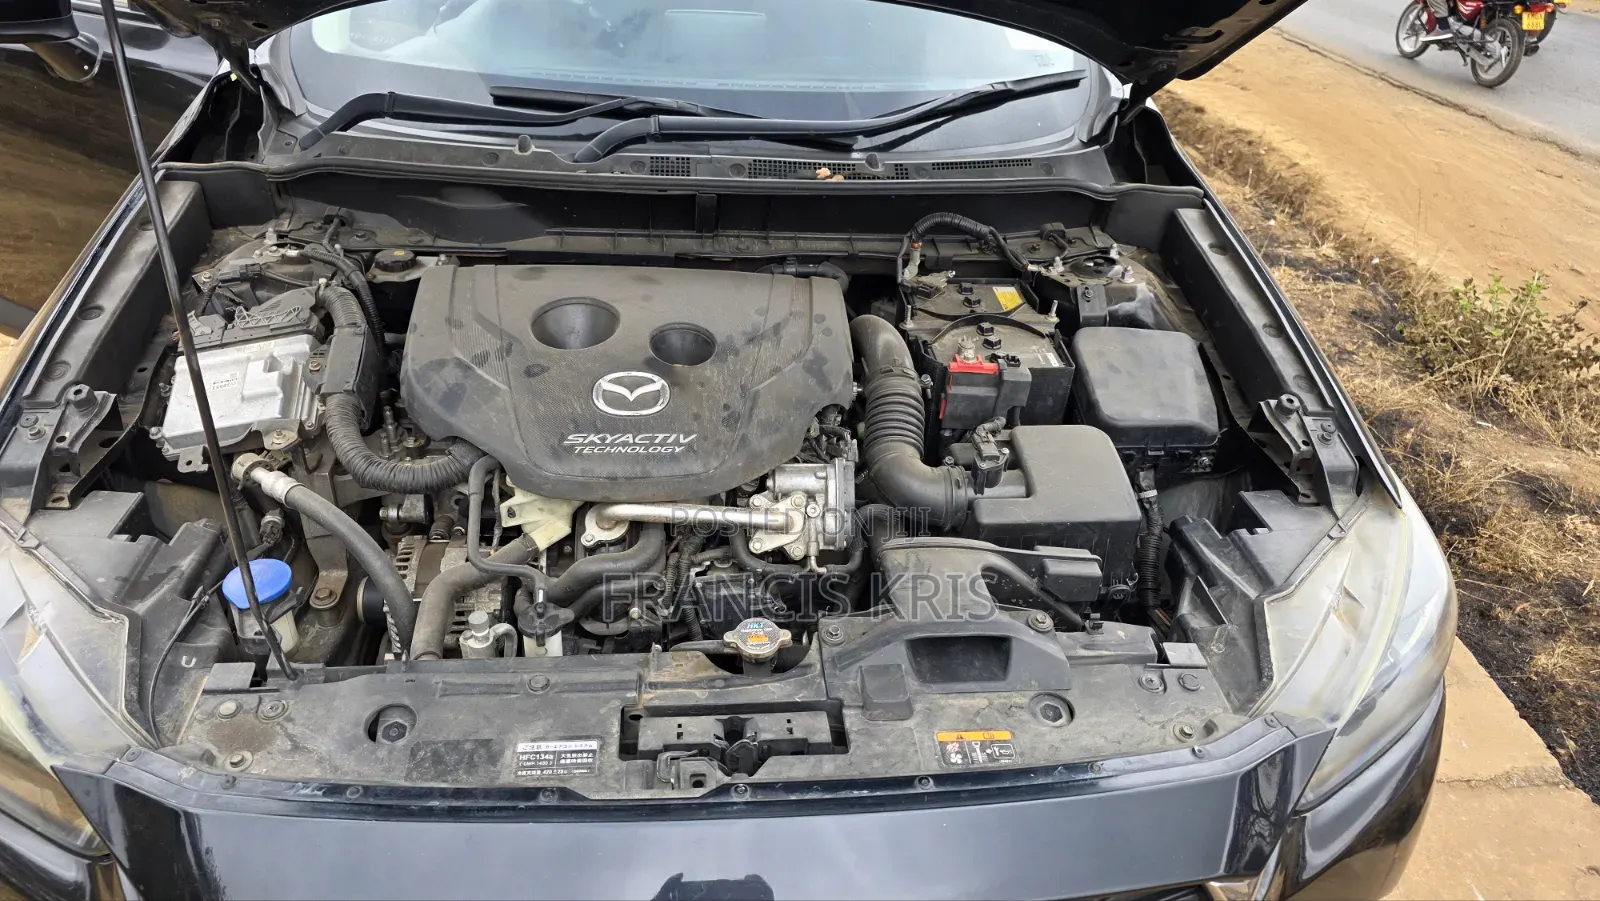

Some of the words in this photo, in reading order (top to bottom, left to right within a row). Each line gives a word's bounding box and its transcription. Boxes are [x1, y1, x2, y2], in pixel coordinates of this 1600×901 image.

[563, 433, 698, 444] SKYACTIV
[574, 446, 686, 454] TECHNOLOGY
[519, 753, 554, 761] HFC134a
